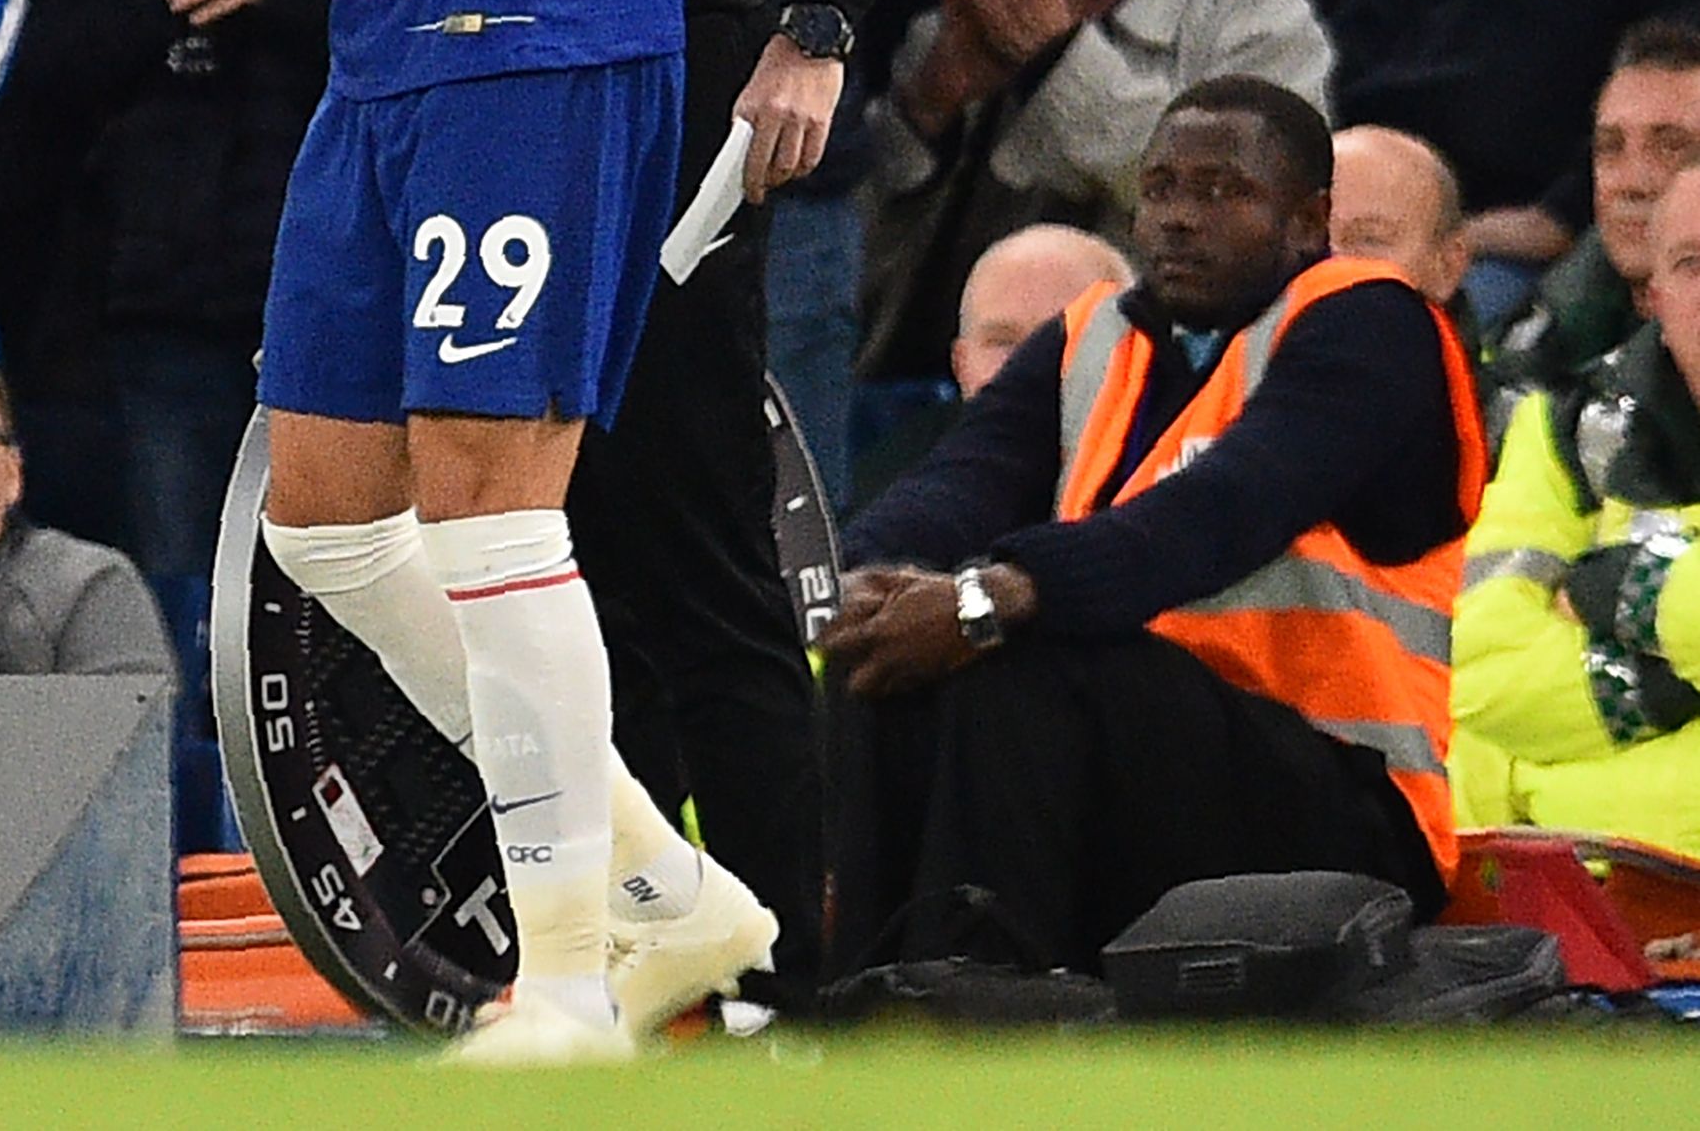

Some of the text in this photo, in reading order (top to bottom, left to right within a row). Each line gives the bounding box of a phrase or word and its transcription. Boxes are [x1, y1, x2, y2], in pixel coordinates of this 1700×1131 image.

[413, 214, 552, 330] 29
[261, 673, 295, 753] 50
[506, 845, 553, 864] CFC
[312, 864, 363, 932] 45
